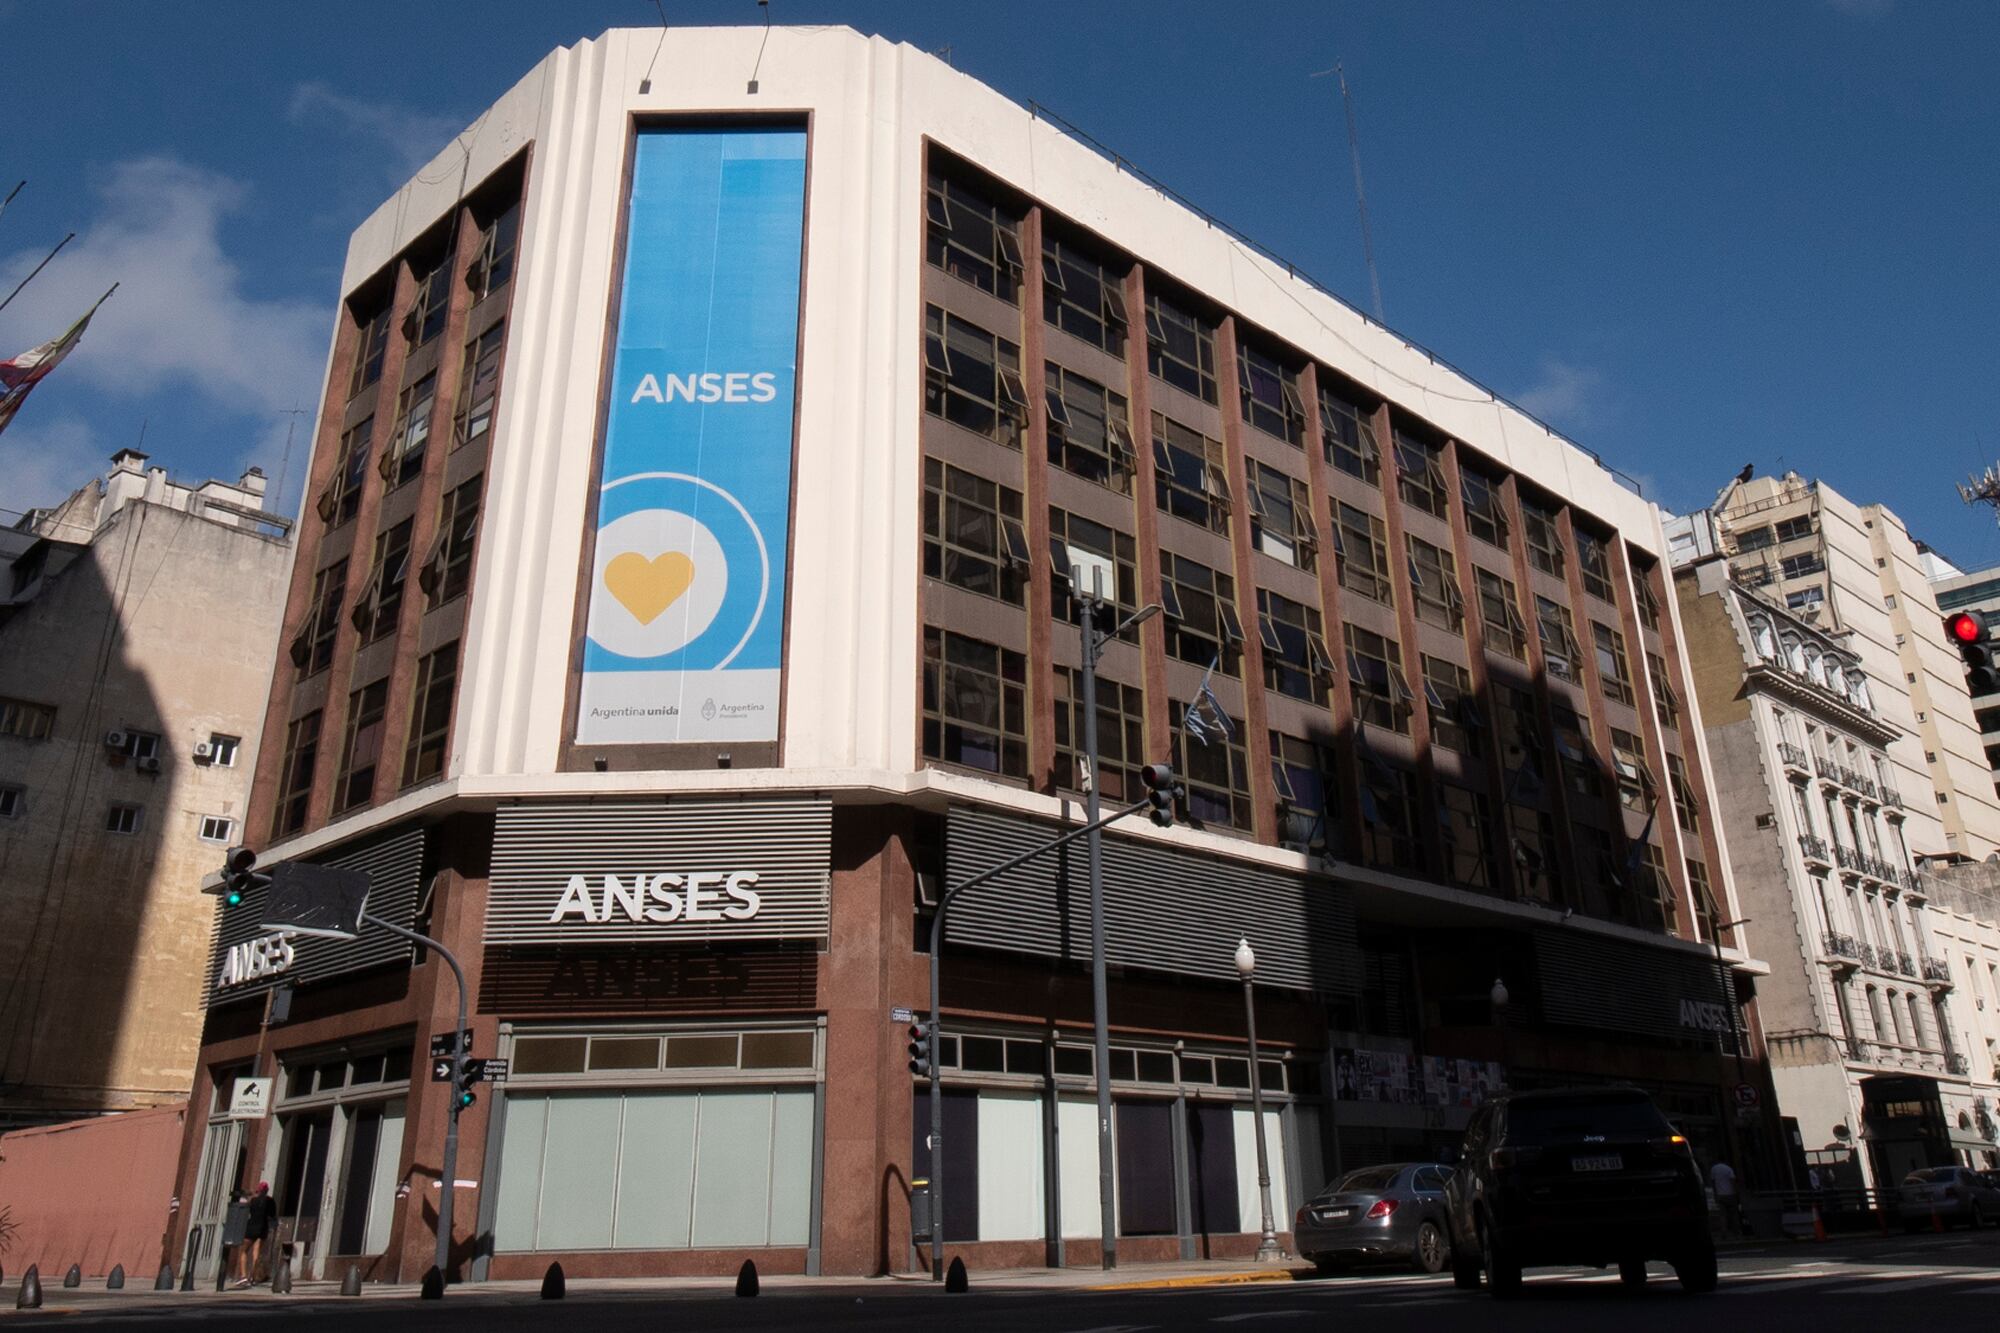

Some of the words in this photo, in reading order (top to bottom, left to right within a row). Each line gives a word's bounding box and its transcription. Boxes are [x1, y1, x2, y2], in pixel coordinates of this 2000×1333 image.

[631, 373, 776, 403] ANSES
[590, 705, 646, 720] Argentina
[647, 706, 679, 717] unida
[719, 703, 765, 713] Argentina
[550, 871, 760, 922] ANSES
[217, 931, 296, 988] ANSES
[1679, 998, 1729, 1032] ANSES
